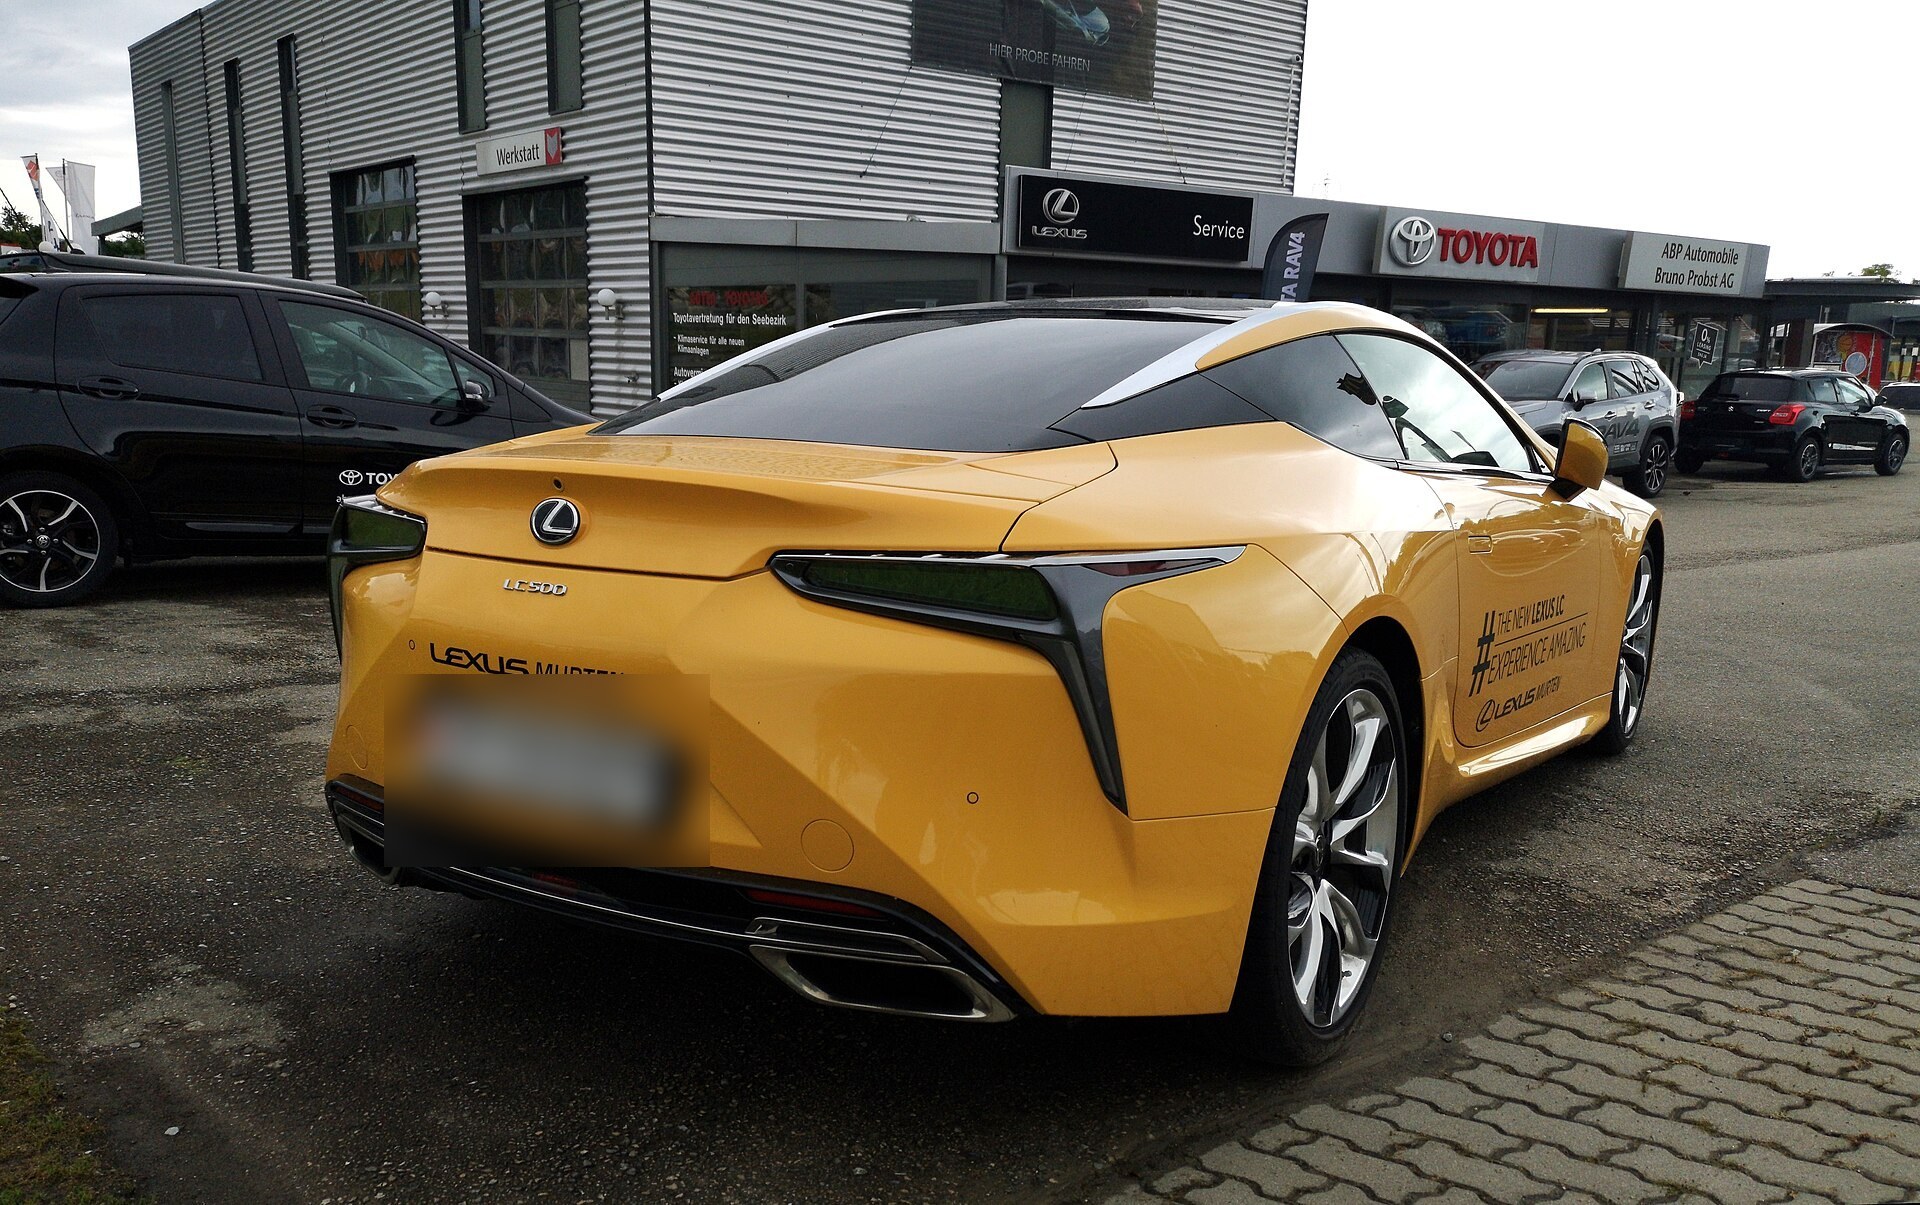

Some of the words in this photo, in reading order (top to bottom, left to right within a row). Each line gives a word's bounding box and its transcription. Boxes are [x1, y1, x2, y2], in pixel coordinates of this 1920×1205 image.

[989, 42, 1013, 59] HIER
[1015, 47, 1049, 65] PROBE
[1051, 53, 1091, 72] FAHREN
[496, 143, 540, 166] Werkstatt
[1031, 225, 1088, 240] LEXUS
[1192, 214, 1245, 240] Service
[1283, 231, 1306, 279] RAV4
[1437, 227, 1539, 269] TOYOTA
[1661, 242, 1684, 260] ABP
[1684, 244, 1739, 265] Automobile
[1654, 267, 1685, 285] Bruno
[1687, 269, 1719, 287] Probst
[1719, 273, 1735, 289] AG
[673, 312, 724, 326] Toyotavertretung
[726, 313, 736, 325] für
[737, 313, 750, 325] den
[752, 313, 787, 326] Seebezirk
[677, 334, 708, 344] Klimaservice
[709, 335, 717, 345] für
[717, 336, 728, 345] alle
[728, 338, 745, 346] neuen
[677, 344, 710, 357] Klimaanlagen
[673, 366, 704, 378] Autoverm
[1497, 609, 1513, 635] THE
[1512, 604, 1532, 629] NEW
[1531, 597, 1556, 624] LEXUS
[1555, 594, 1565, 616] LC
[430, 642, 530, 674] LEXUS
[1487, 636, 1548, 684] EXPERIENCE
[1546, 622, 1586, 662] AMAZING
[1494, 687, 1537, 720] LEXUS
[1534, 676, 1562, 702] MURTEN
